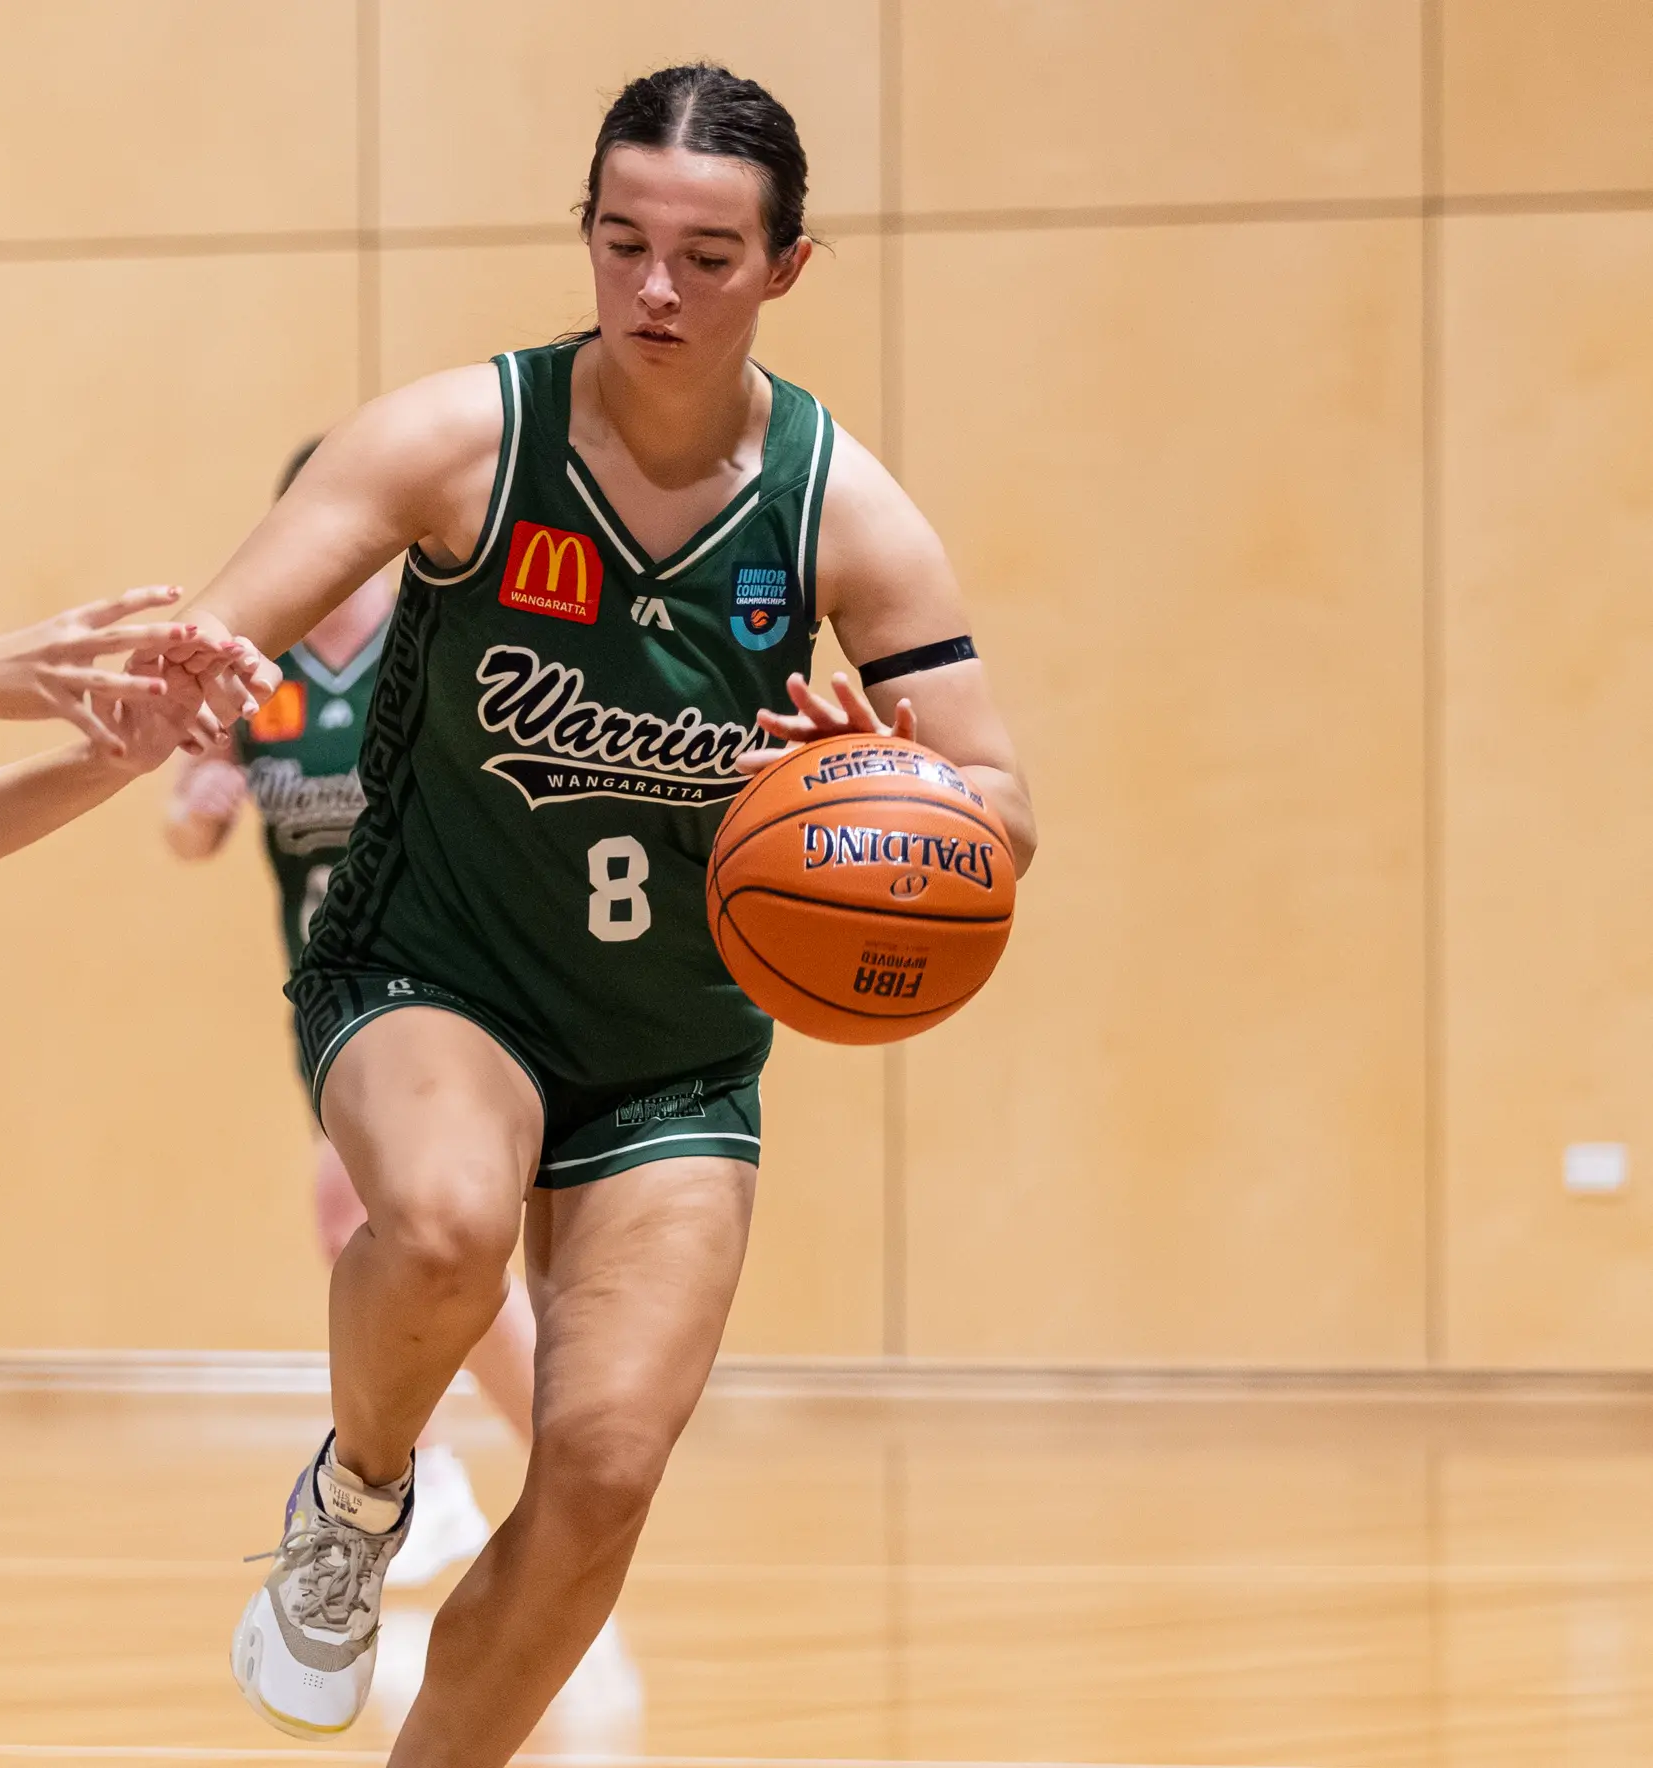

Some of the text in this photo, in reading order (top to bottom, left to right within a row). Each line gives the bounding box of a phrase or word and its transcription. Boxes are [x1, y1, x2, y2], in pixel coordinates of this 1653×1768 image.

[737, 568, 787, 585] JUNIOR
[510, 590, 587, 617] WANGARATTA
[736, 584, 787, 598] COUNTRY
[736, 596, 787, 606] CHAMPIONSHIPS
[547, 773, 704, 799] WANGARATTA
[803, 823, 993, 892] SPALDING
[587, 835, 652, 942] 8
[853, 966, 924, 999] FIBA
